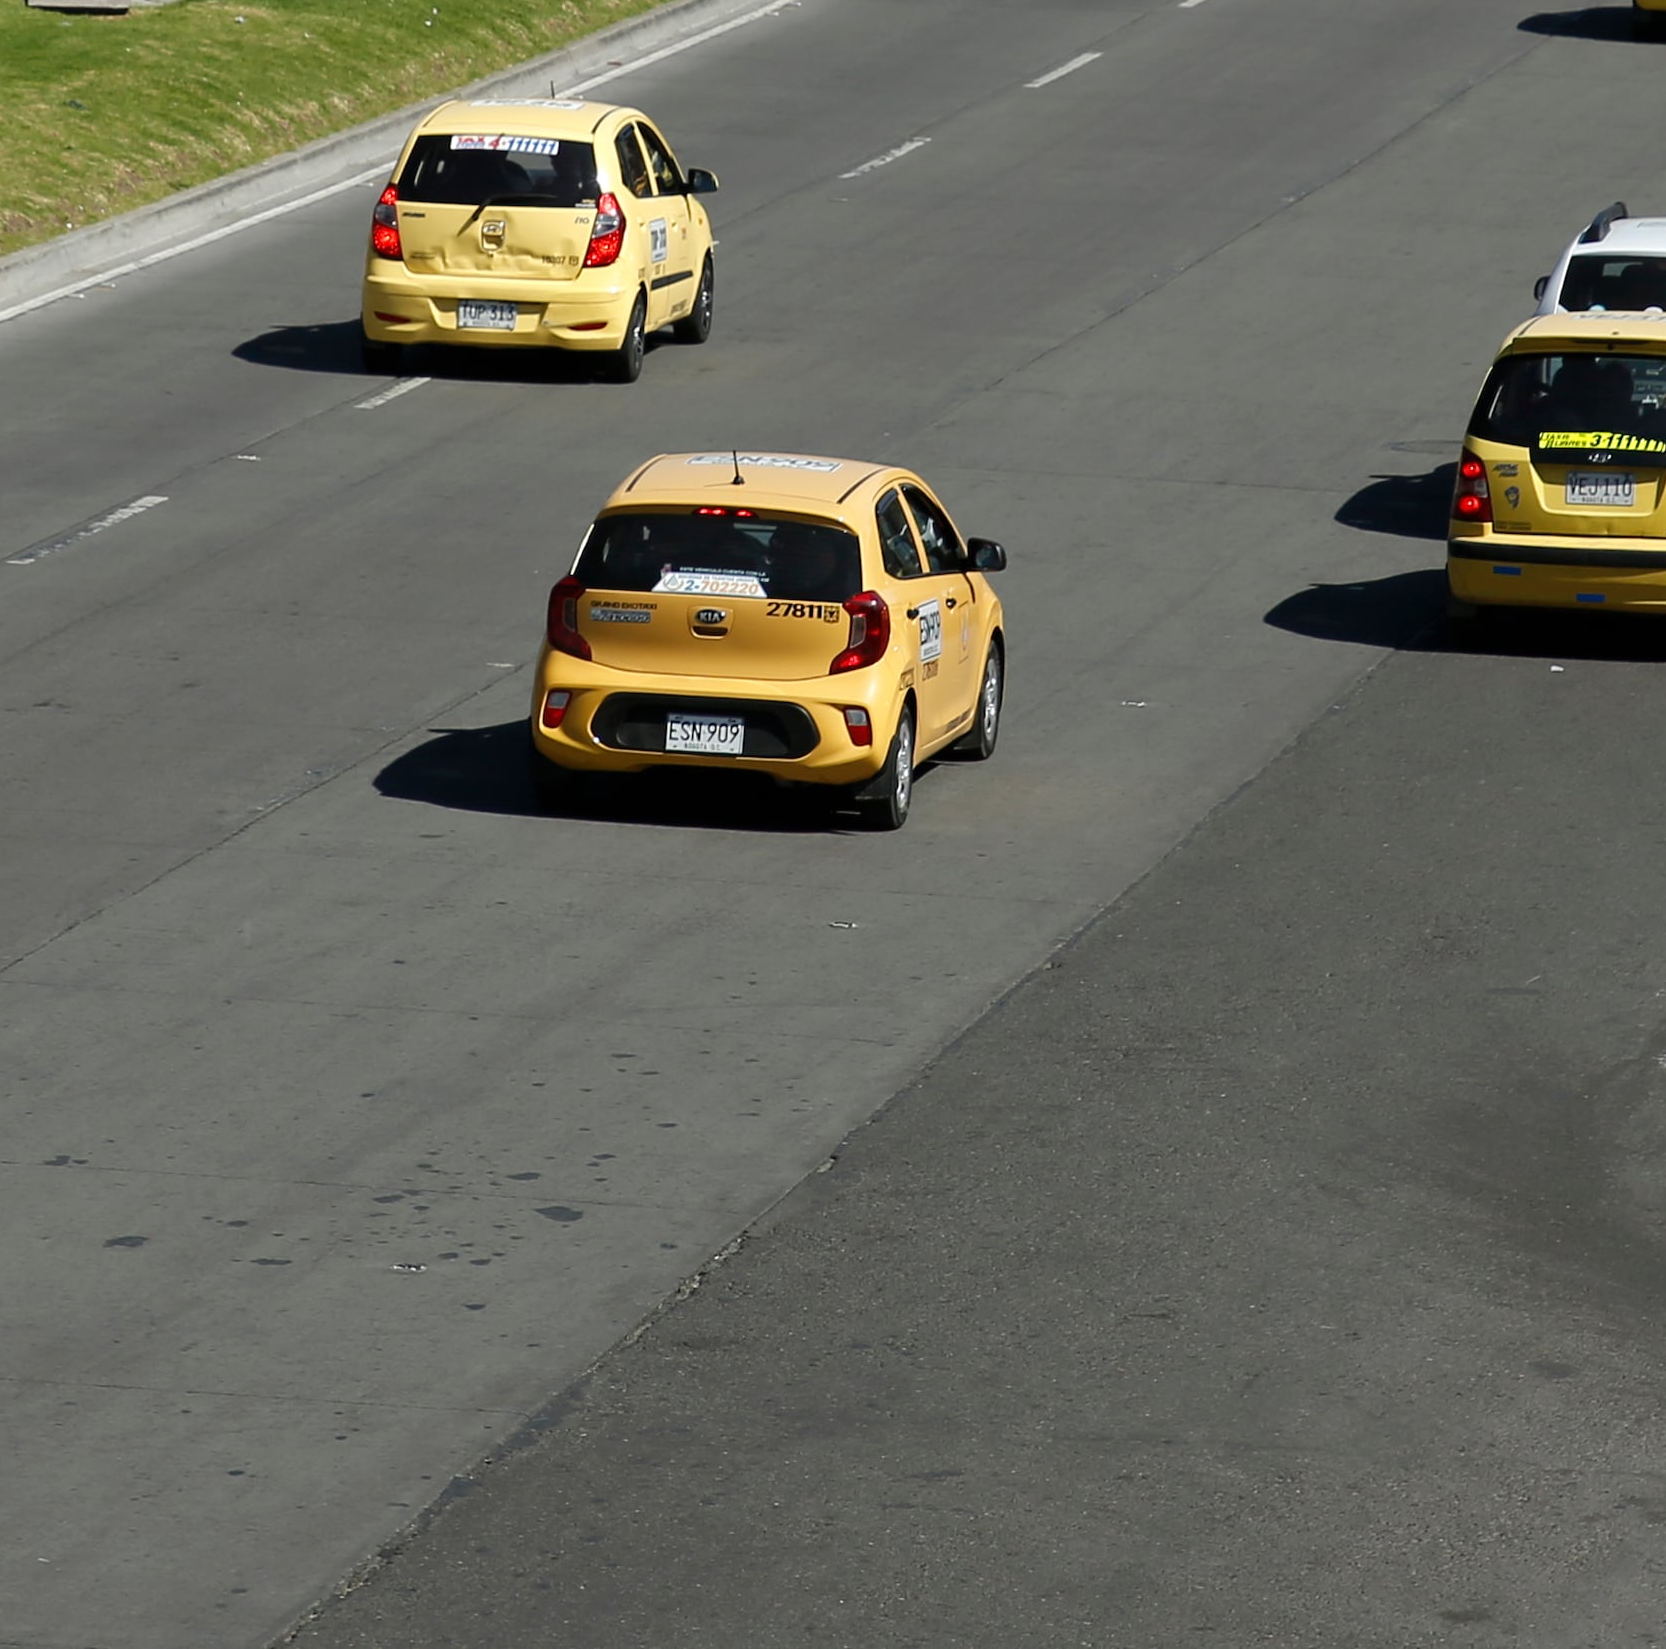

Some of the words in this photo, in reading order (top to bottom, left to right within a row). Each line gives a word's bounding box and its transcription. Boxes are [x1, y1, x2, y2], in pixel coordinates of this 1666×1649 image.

[684, 579, 759, 595] 2-702220
[699, 612, 722, 623] KIA
[766, 601, 823, 619] 27811
[669, 721, 703, 743] ESN
[707, 723, 741, 744] 909
